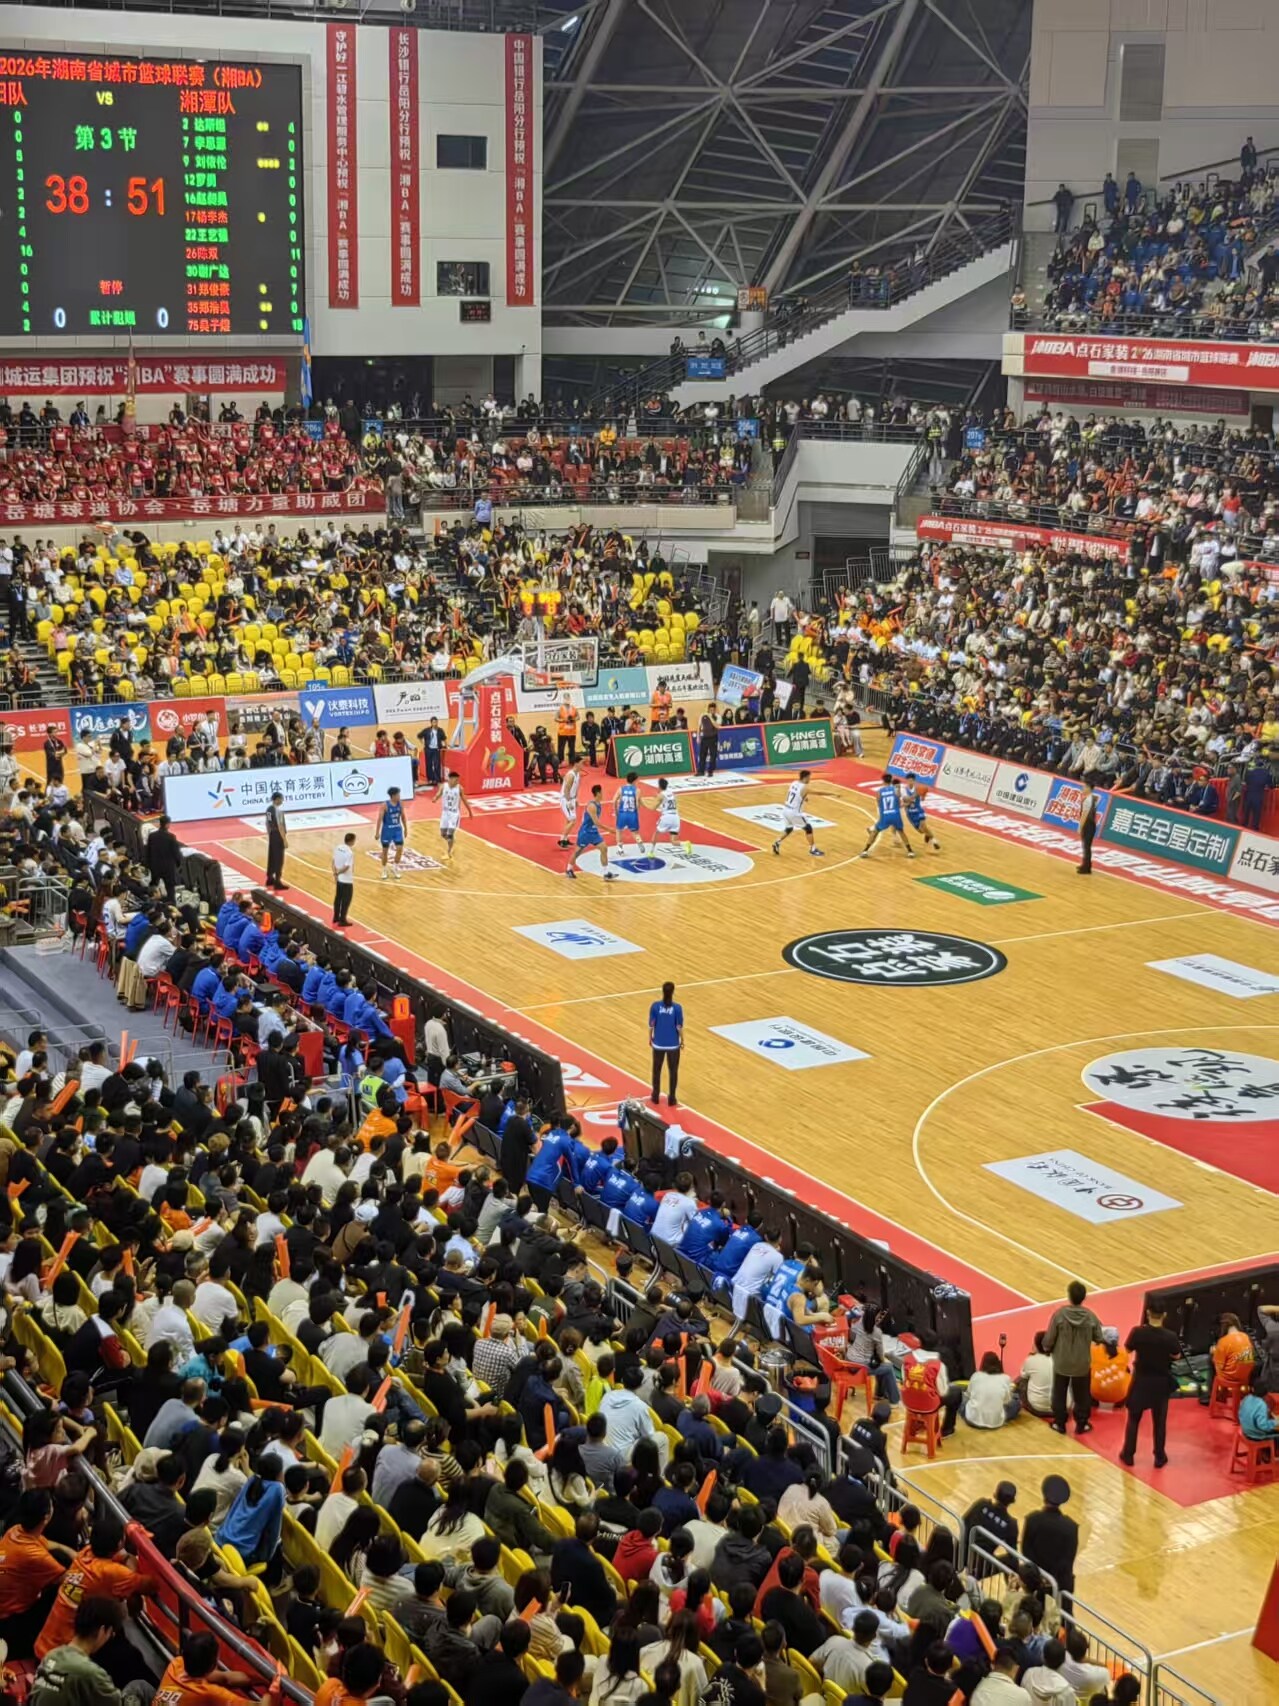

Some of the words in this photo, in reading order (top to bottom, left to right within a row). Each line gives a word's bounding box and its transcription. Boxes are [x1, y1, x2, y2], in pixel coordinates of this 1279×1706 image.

[180, 89, 236, 114] 湘潭队
[45, 174, 89, 214] 38
[127, 177, 166, 216] 51
[54, 307, 66, 328] 0
[157, 308, 169, 328] 0
[790, 729, 826, 740] HNEG
[643, 742, 682, 754] HNEG
[240, 776, 326, 797] 中国体育彩票
[242, 798, 264, 806] CHINA
[294, 792, 326, 801] LOTTERY
[882, 796, 895, 811] 17
[1109, 807, 1231, 864] 嘉宝全屋定制
